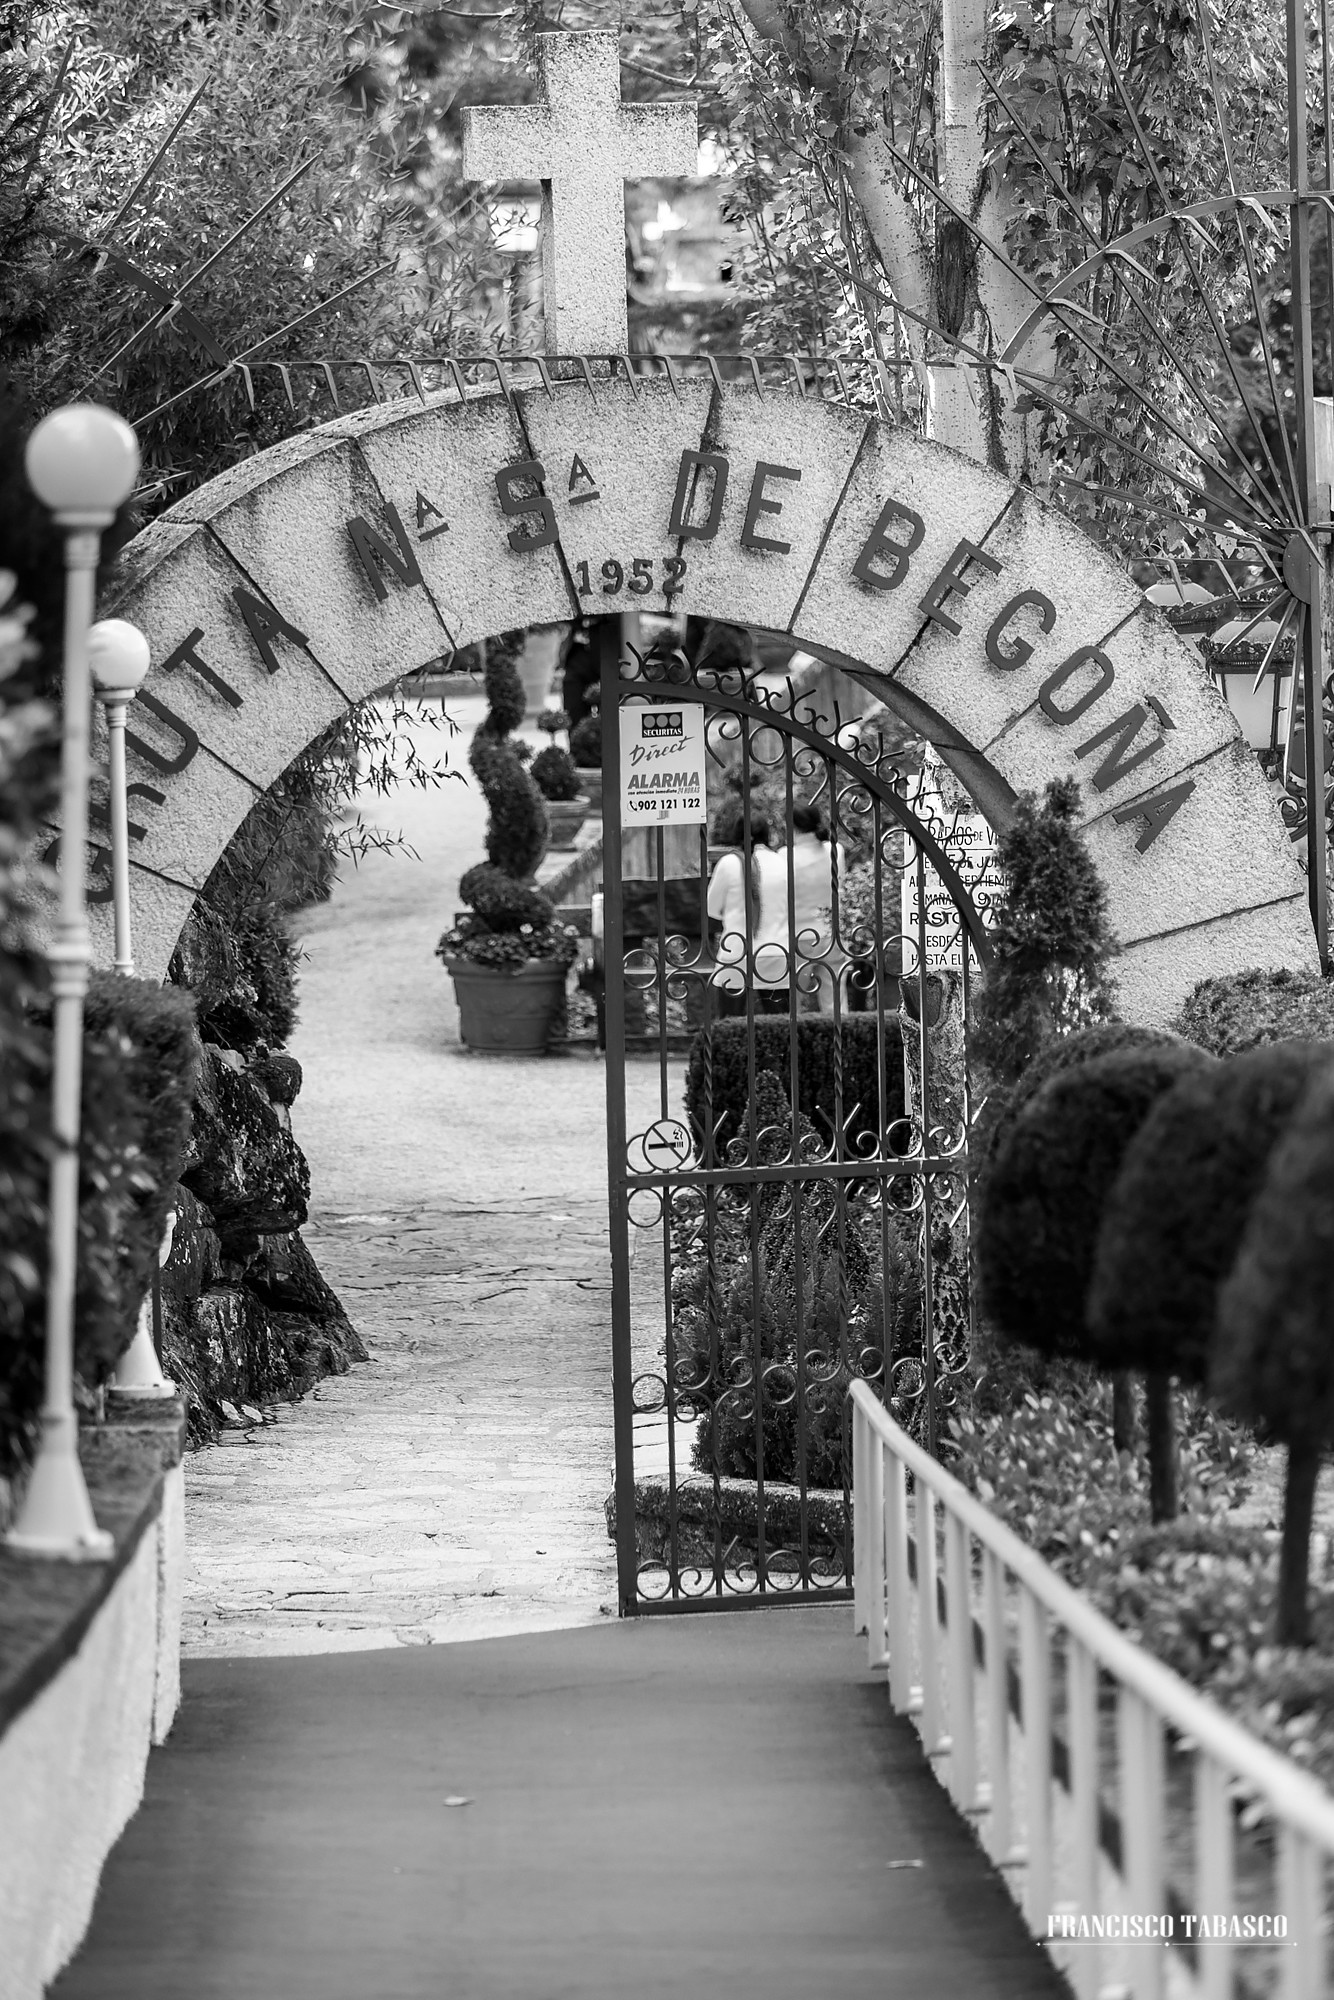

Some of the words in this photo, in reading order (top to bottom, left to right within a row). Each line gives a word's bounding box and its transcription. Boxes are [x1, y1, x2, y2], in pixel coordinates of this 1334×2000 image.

[576, 556, 688, 597] 1952
[668, 449, 801, 554] DE
[851, 497, 1197, 856] BEGOÑA
[643, 728, 682, 736] SECURITAS
[629, 736, 695, 766] Direct
[627, 772, 700, 789] ALARMA
[684, 786, 701, 794] HORAS
[638, 800, 657, 811] 902
[661, 799, 678, 809] 121
[682, 798, 700, 808] 122
[911, 953, 948, 965] HSTA
